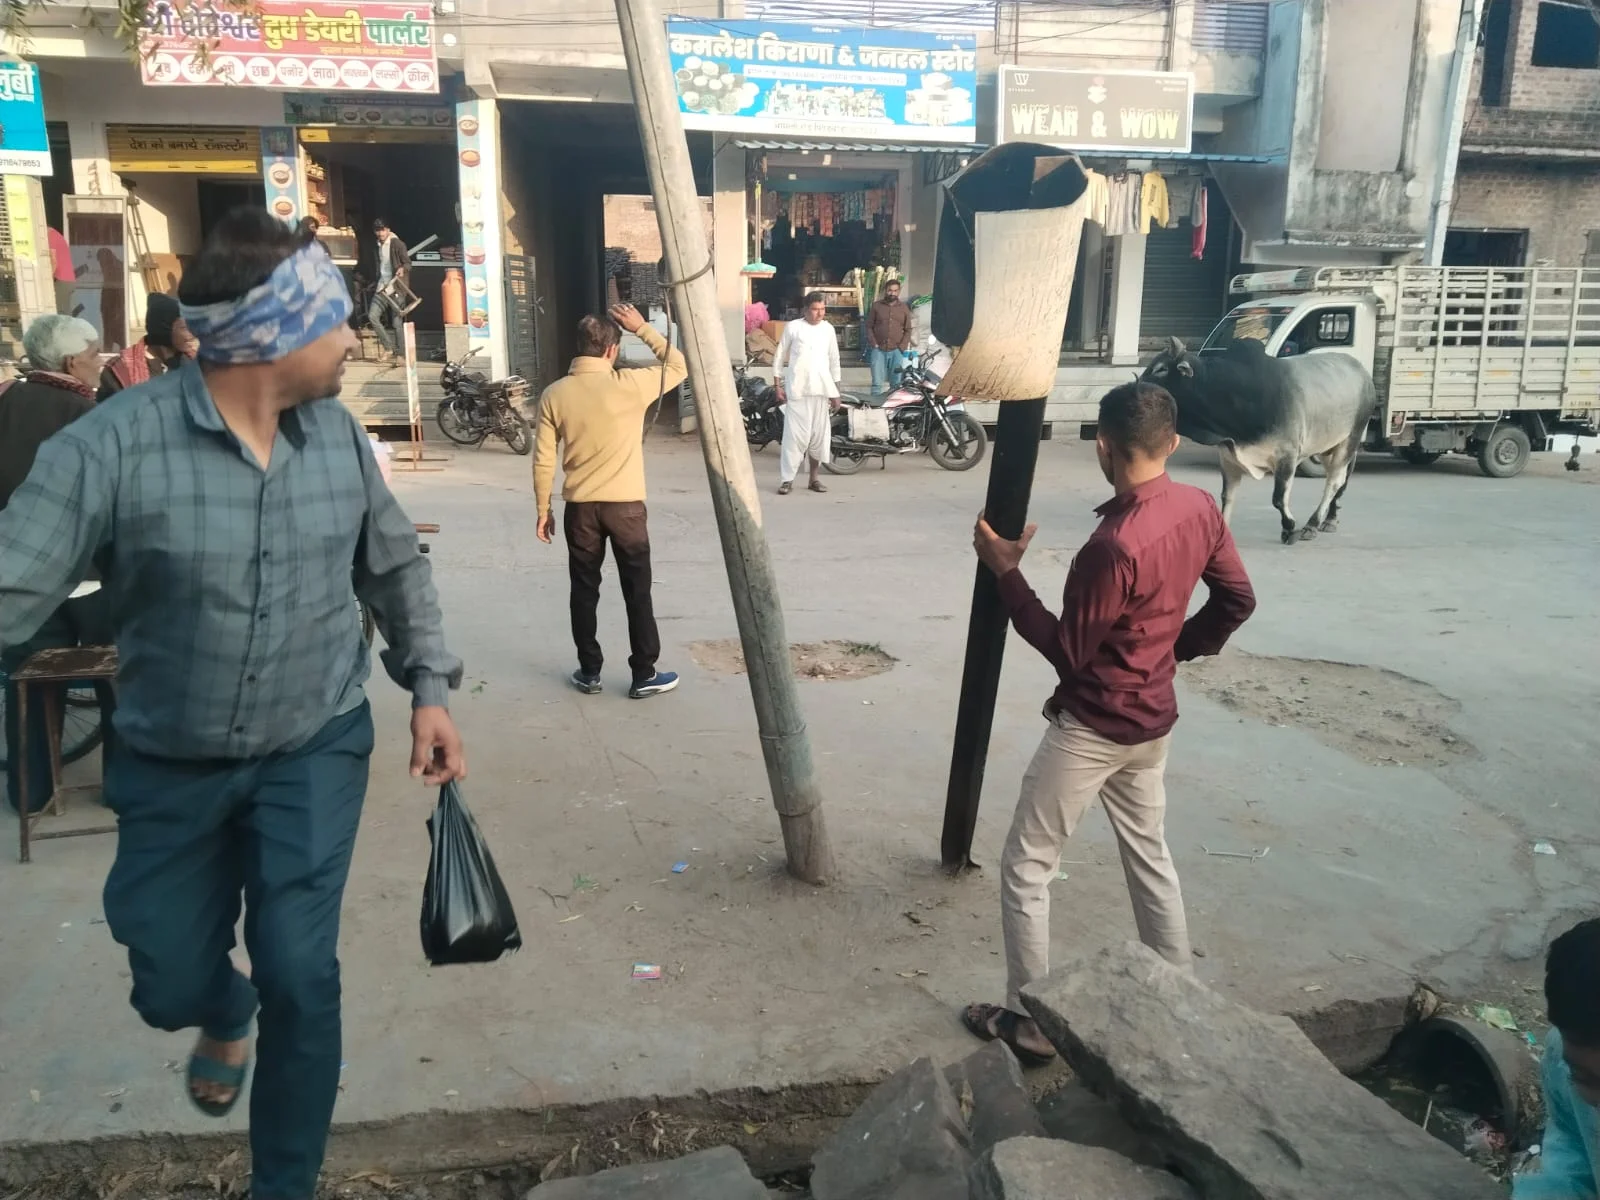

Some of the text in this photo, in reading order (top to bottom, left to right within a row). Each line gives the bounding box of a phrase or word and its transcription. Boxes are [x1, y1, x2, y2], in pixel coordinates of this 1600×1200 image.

[301, 8, 362, 44] डेयरी
[364, 10, 430, 48] पार्लर
[669, 29, 976, 72] कमलेश किराणा & जनरल स्टोर
[1011, 103, 1180, 140] WEAR & WOW
